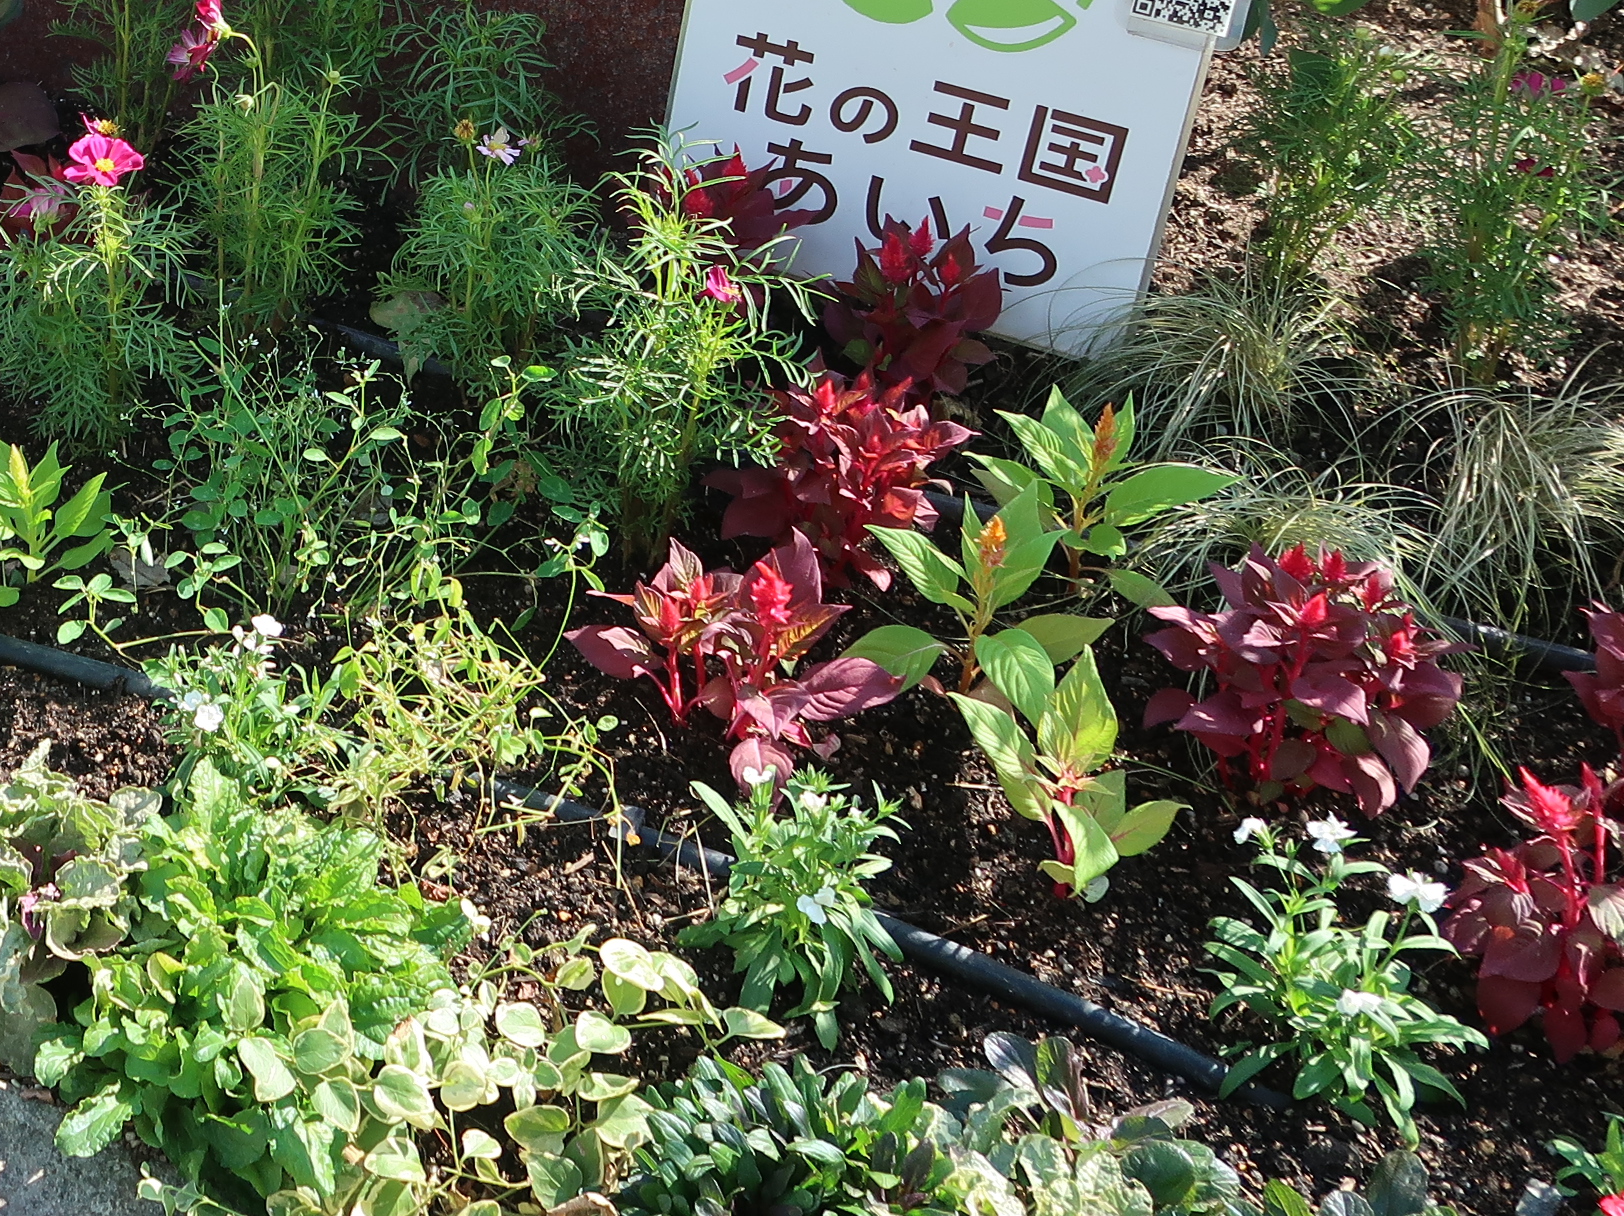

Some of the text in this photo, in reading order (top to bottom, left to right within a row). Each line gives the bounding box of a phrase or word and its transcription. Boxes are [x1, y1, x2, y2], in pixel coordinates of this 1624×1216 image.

[724, 33, 1129, 204] 花の王国
[762, 140, 1058, 286] あいち
